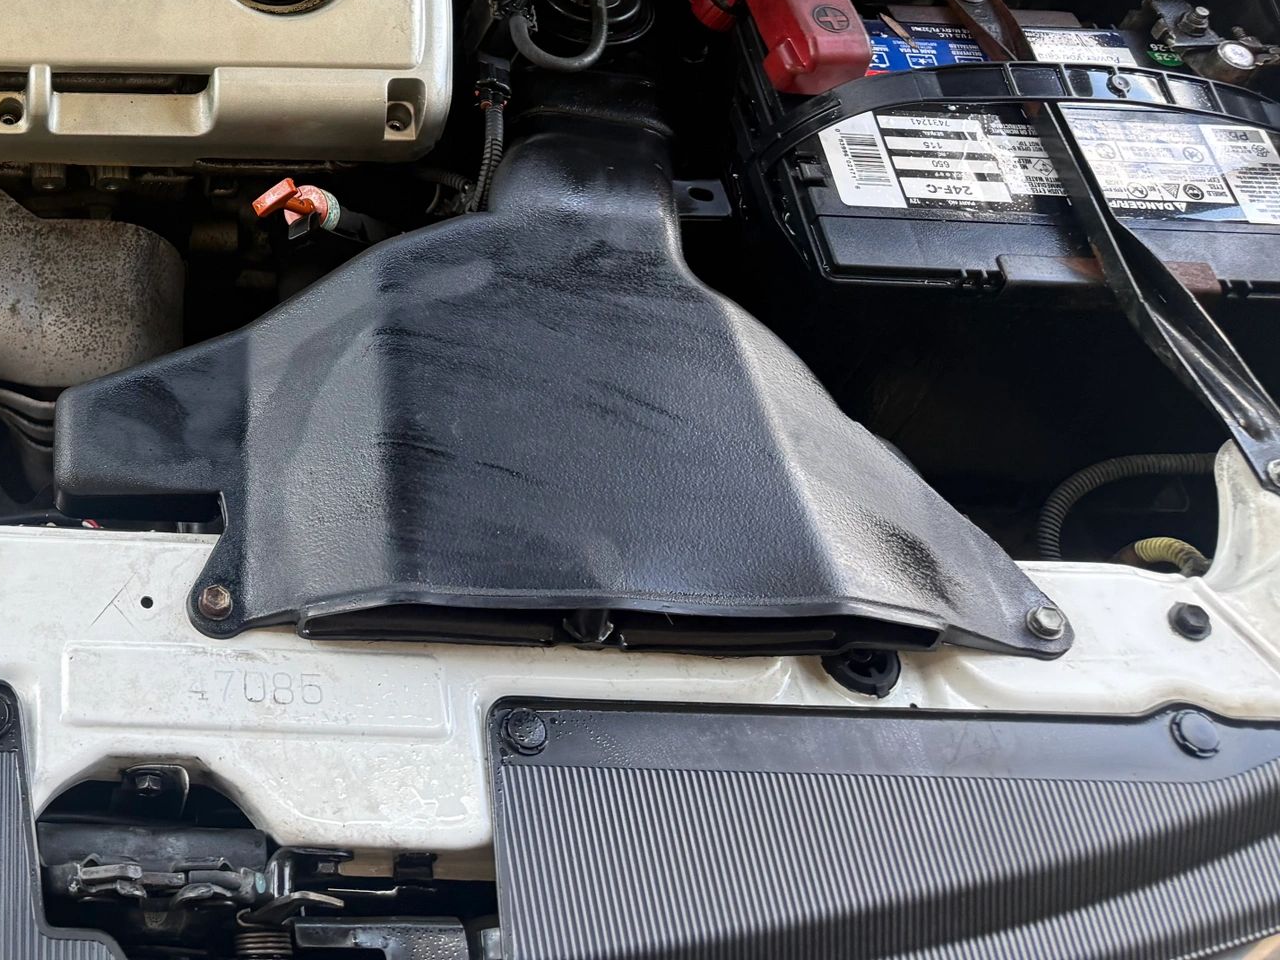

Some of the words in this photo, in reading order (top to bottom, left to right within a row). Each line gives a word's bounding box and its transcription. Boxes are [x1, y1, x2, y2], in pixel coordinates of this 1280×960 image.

[923, 141, 943, 149] 115
[931, 160, 950, 168] 650
[926, 184, 973, 195] 24F-C
